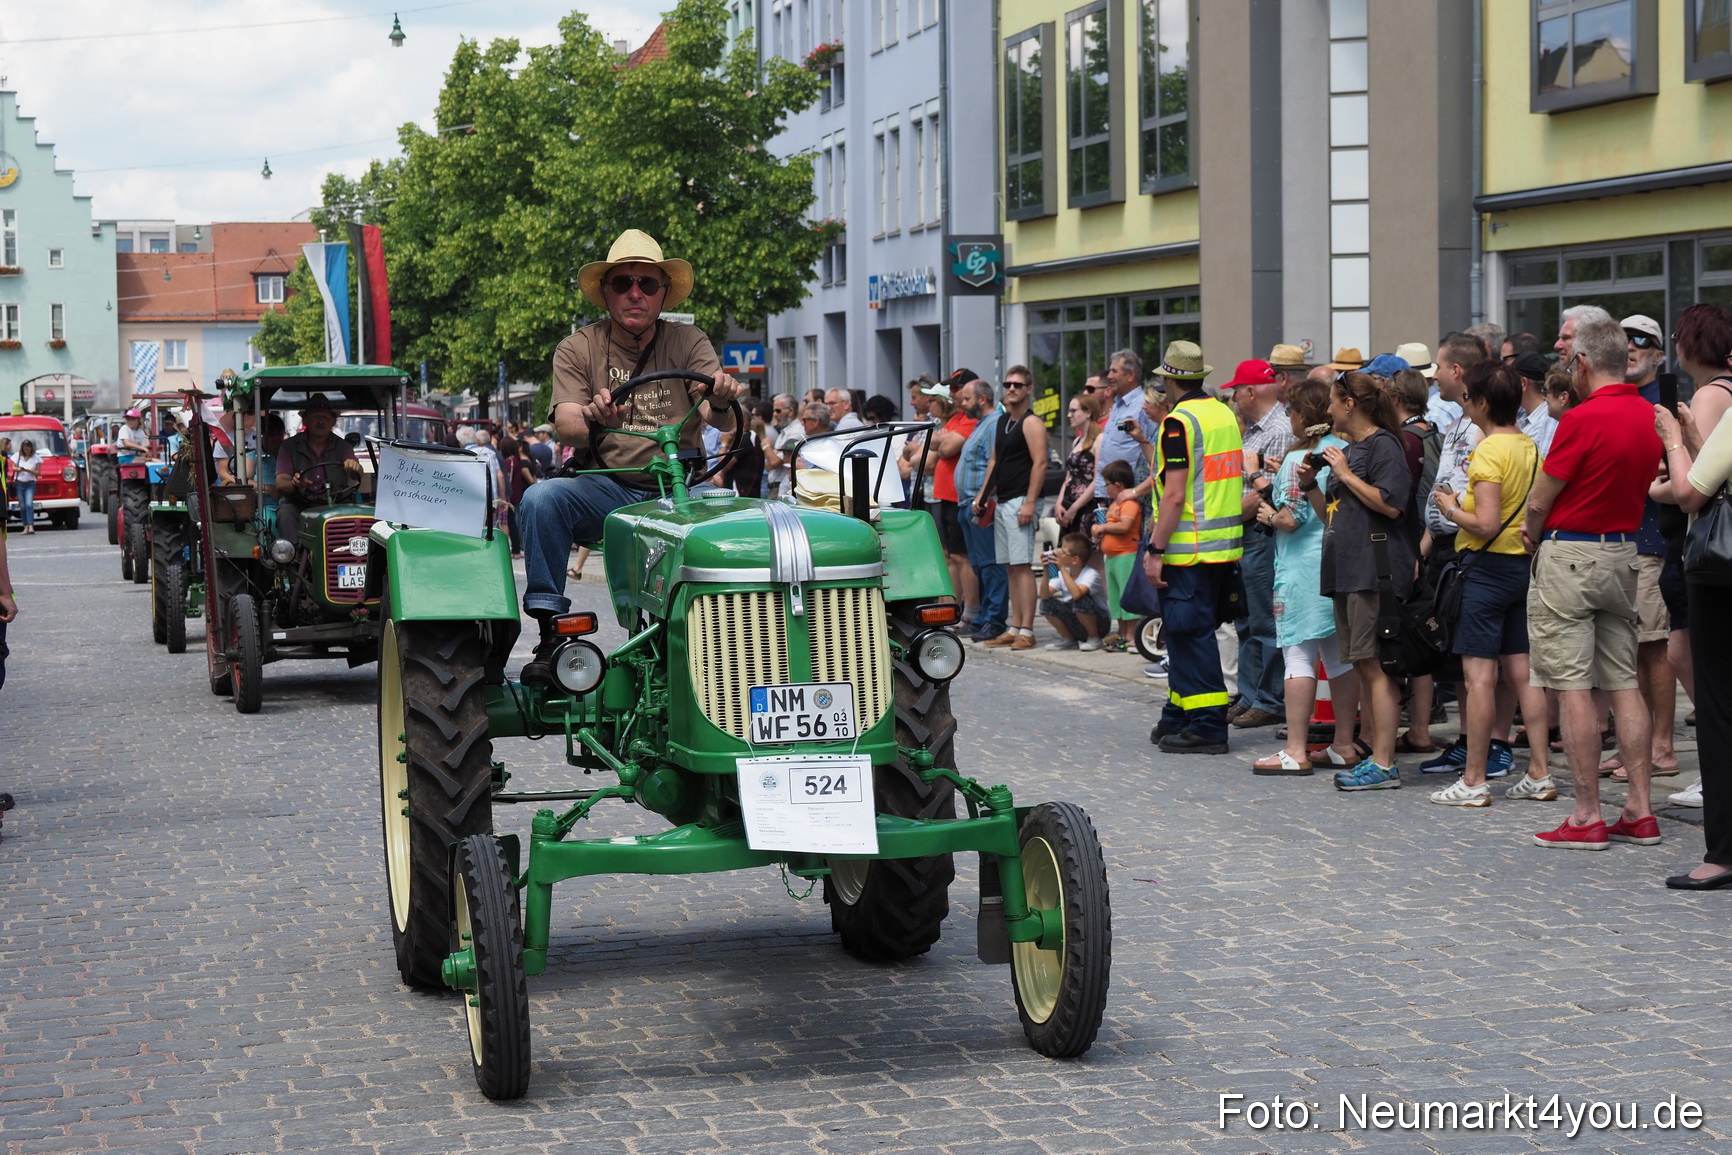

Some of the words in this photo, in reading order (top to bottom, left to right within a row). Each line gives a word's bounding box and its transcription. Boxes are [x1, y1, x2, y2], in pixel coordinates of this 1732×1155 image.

[966, 250, 987, 276] G2
[397, 458, 424, 475] Bitte
[432, 470, 455, 480] nur
[383, 472, 401, 483] mit
[405, 477, 426, 487] den
[431, 482, 463, 495] Augen
[393, 489, 447, 505] anschauen
[756, 703, 763, 712] D
[770, 688, 805, 713] NM
[757, 714, 790, 740] WF
[796, 713, 827, 738] 56
[833, 712, 848, 722] 03
[834, 726, 849, 737] 10
[804, 774, 848, 796] 524
